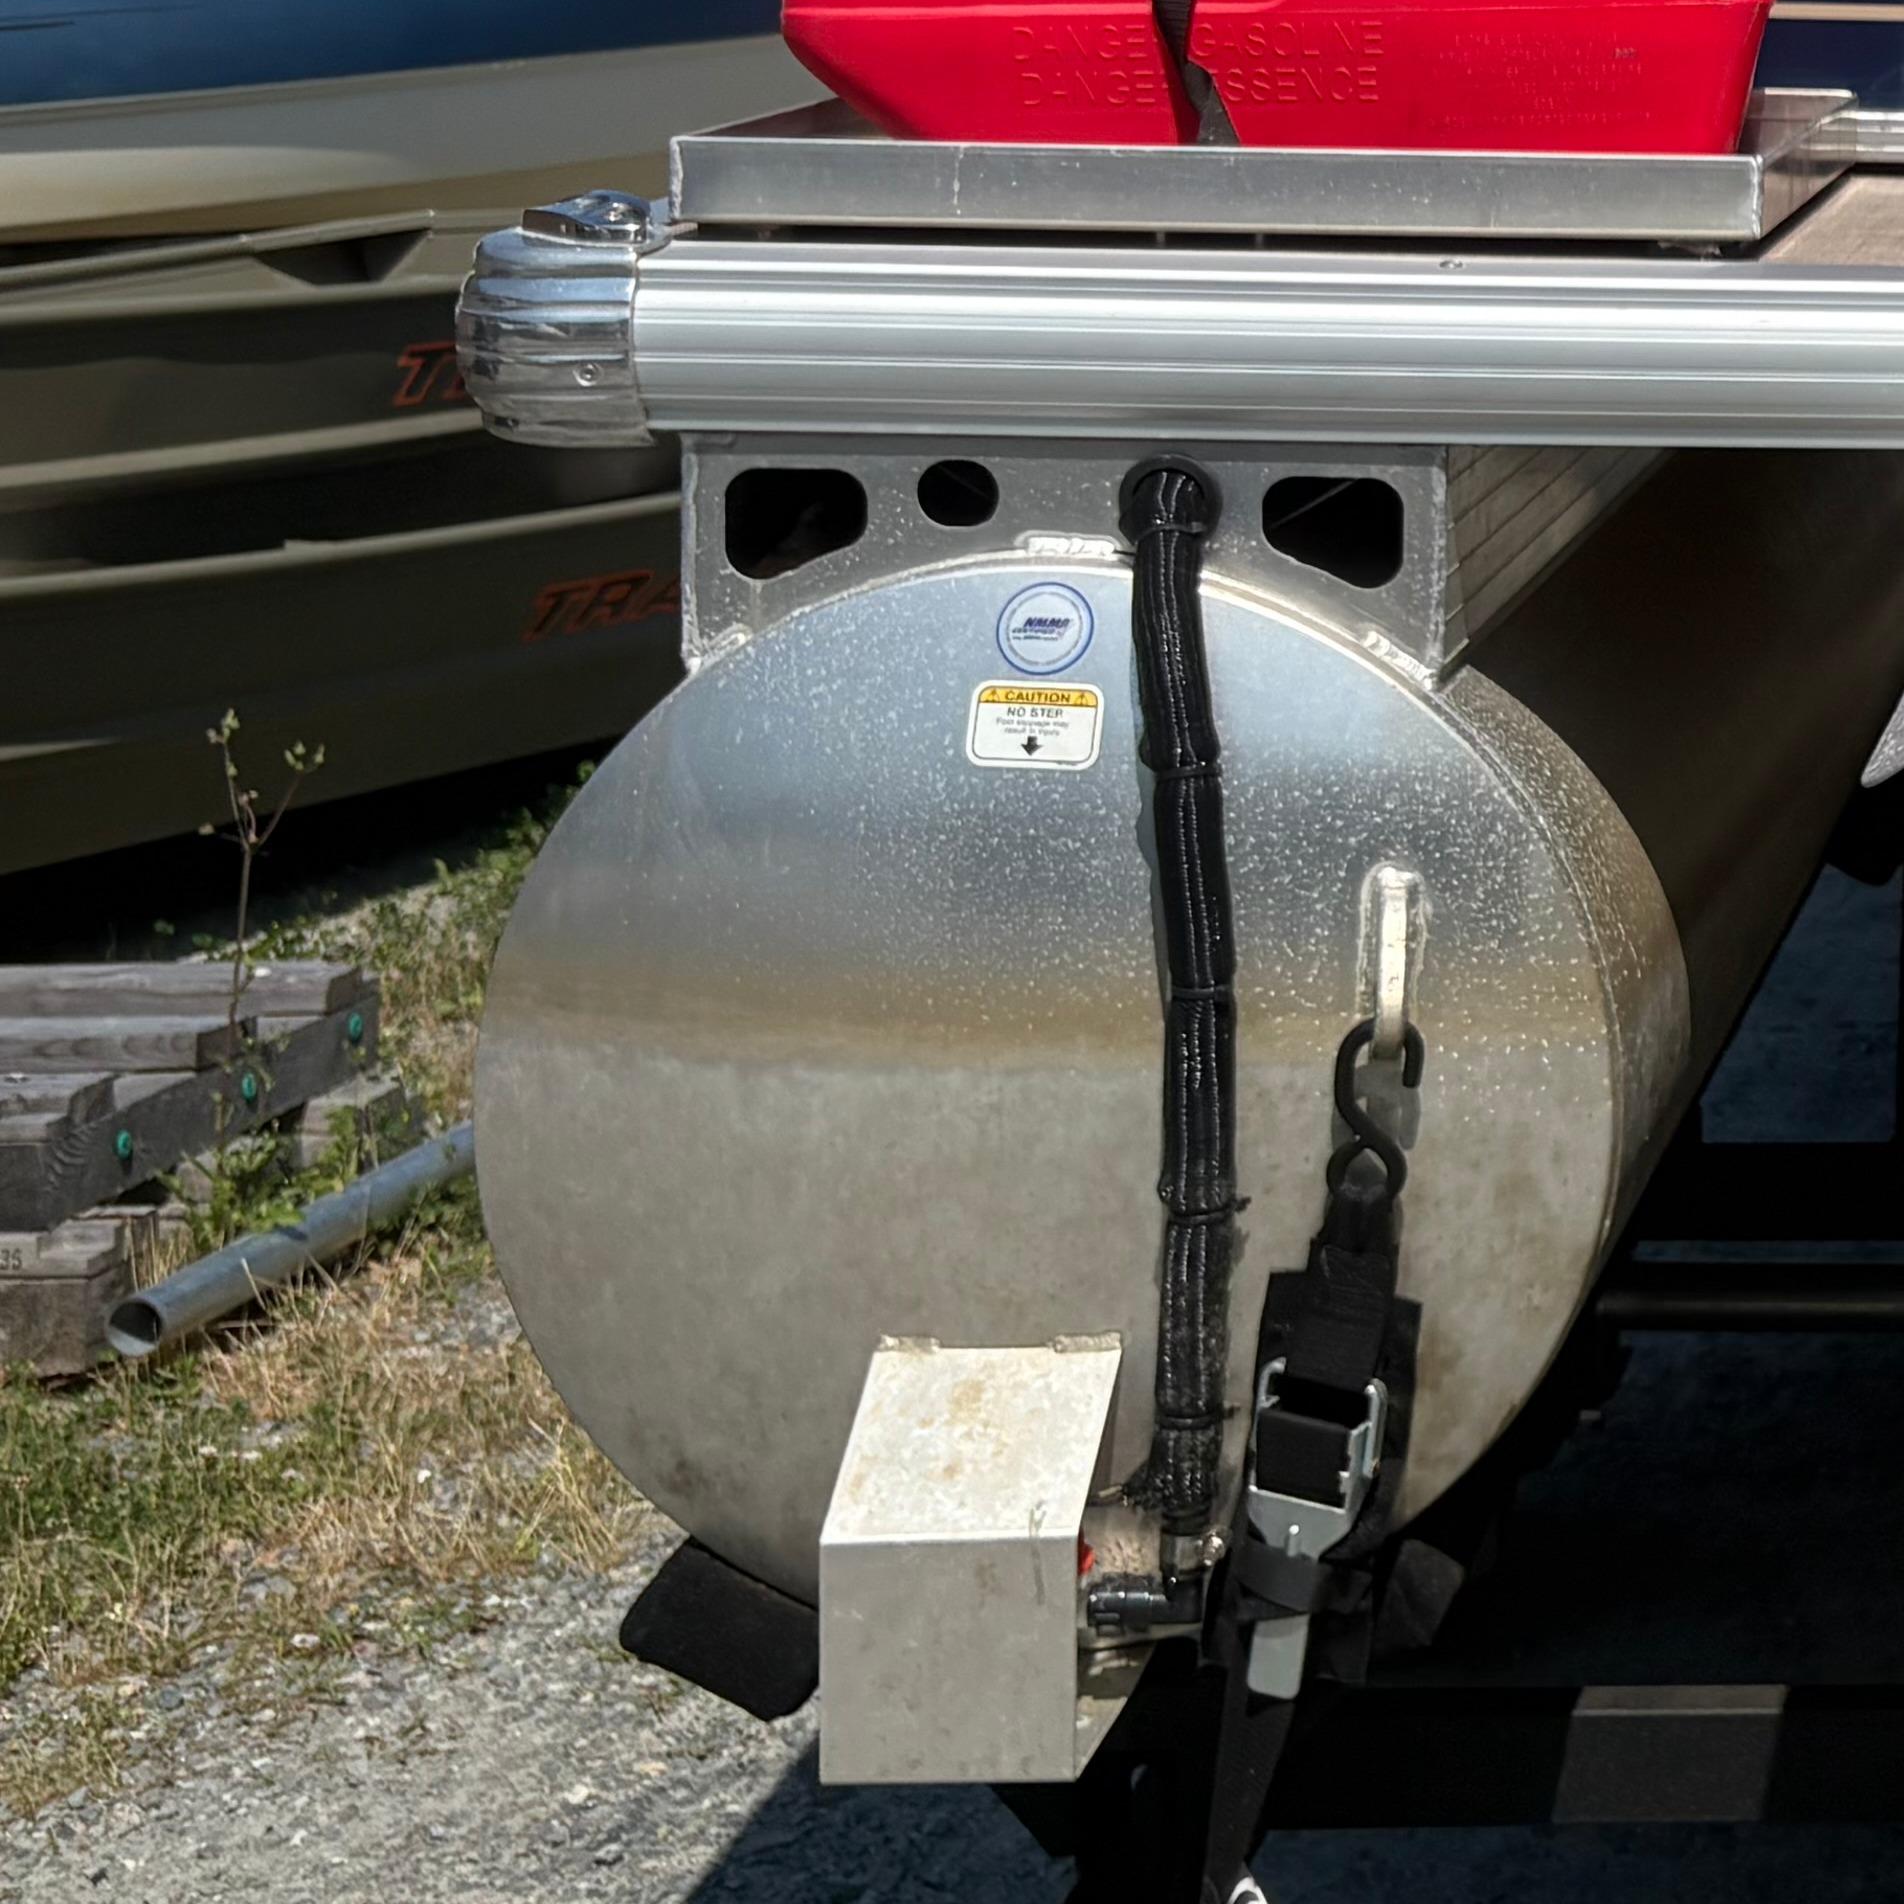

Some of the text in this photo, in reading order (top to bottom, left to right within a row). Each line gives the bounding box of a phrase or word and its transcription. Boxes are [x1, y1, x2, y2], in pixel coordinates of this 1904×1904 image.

[1191, 20, 1385, 57] GASOLINE
[1004, 690, 1071, 704] CAUTION
[1007, 706, 1026, 718] NO
